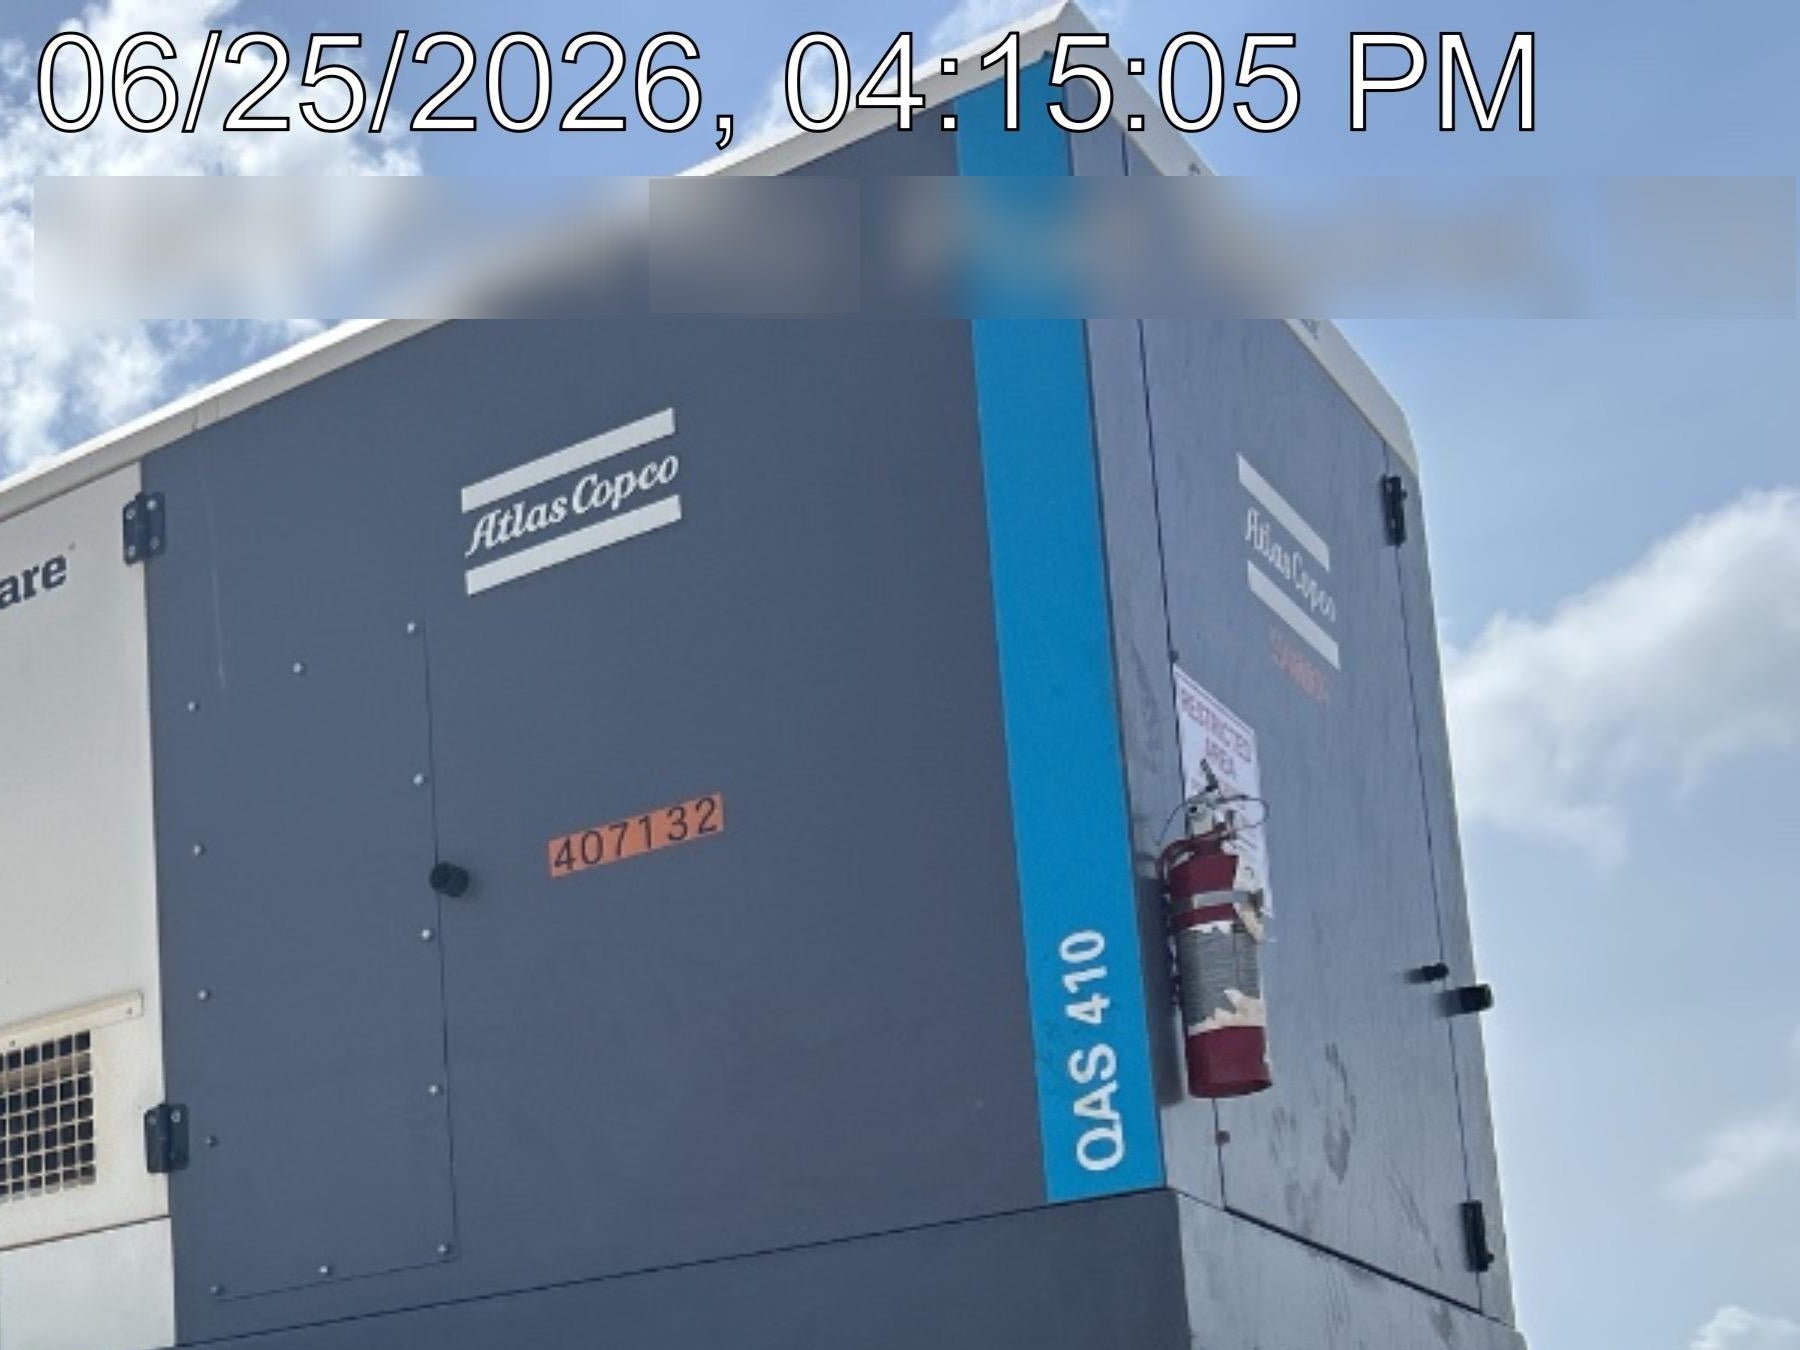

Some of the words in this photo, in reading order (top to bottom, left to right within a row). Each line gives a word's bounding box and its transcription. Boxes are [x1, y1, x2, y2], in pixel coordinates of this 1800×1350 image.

[465, 496, 568, 559] Atlas
[571, 455, 679, 514] Copco
[553, 796, 719, 872] 407132
[1058, 929, 1111, 1026] 410
[1067, 1043, 1125, 1171] QAS
